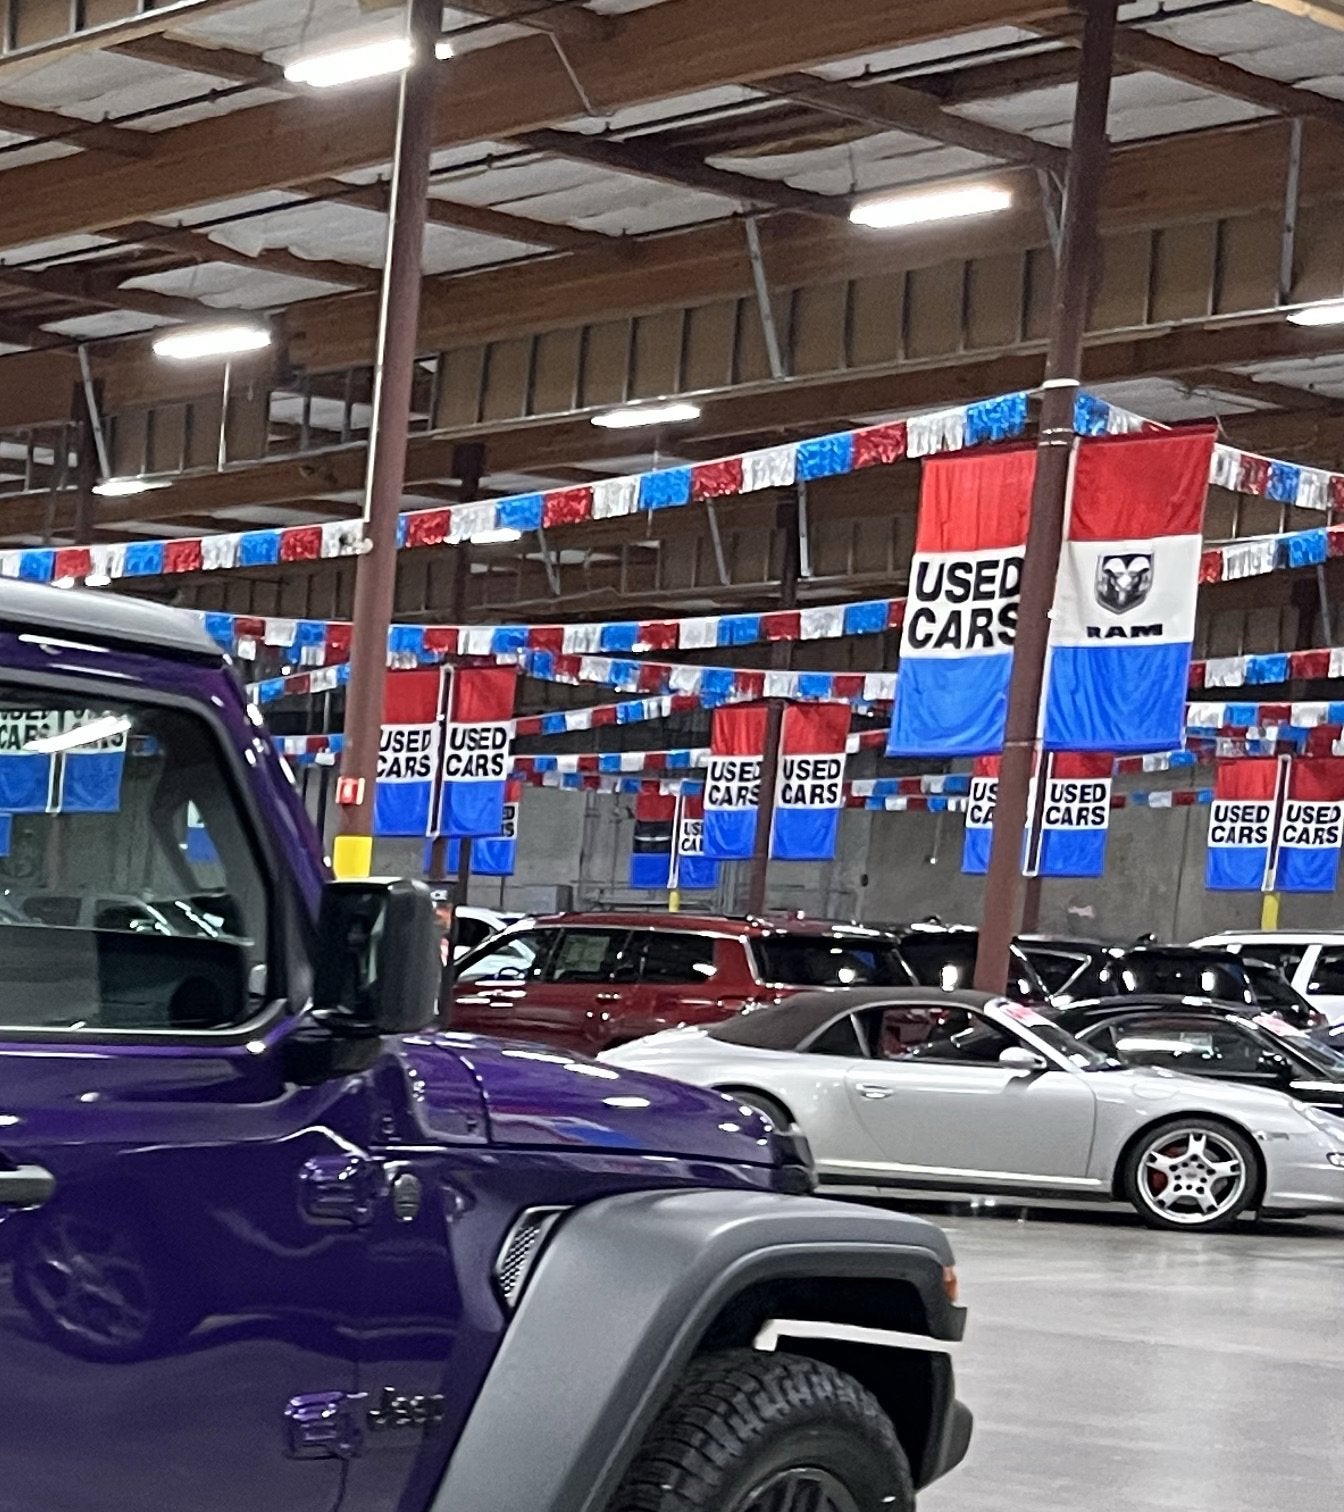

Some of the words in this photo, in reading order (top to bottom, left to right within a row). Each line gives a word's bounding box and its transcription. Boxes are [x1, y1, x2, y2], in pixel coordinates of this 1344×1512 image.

[916, 556, 1025, 603] USED
[908, 603, 1018, 650] CARS
[1086, 624, 1164, 639] RAM
[450, 727, 507, 752] USED
[446, 753, 504, 777] CARS
[711, 760, 761, 783] USED
[783, 759, 841, 780] USED
[708, 784, 760, 807] CARS
[781, 783, 838, 805] CARS
[973, 782, 999, 803] US
[1050, 783, 1107, 804] USED
[1045, 805, 1106, 827] CARS
[1214, 805, 1270, 823] USED
[1286, 804, 1342, 825] USED
[1211, 825, 1268, 844] CARS
[1282, 825, 1339, 845] CARS
